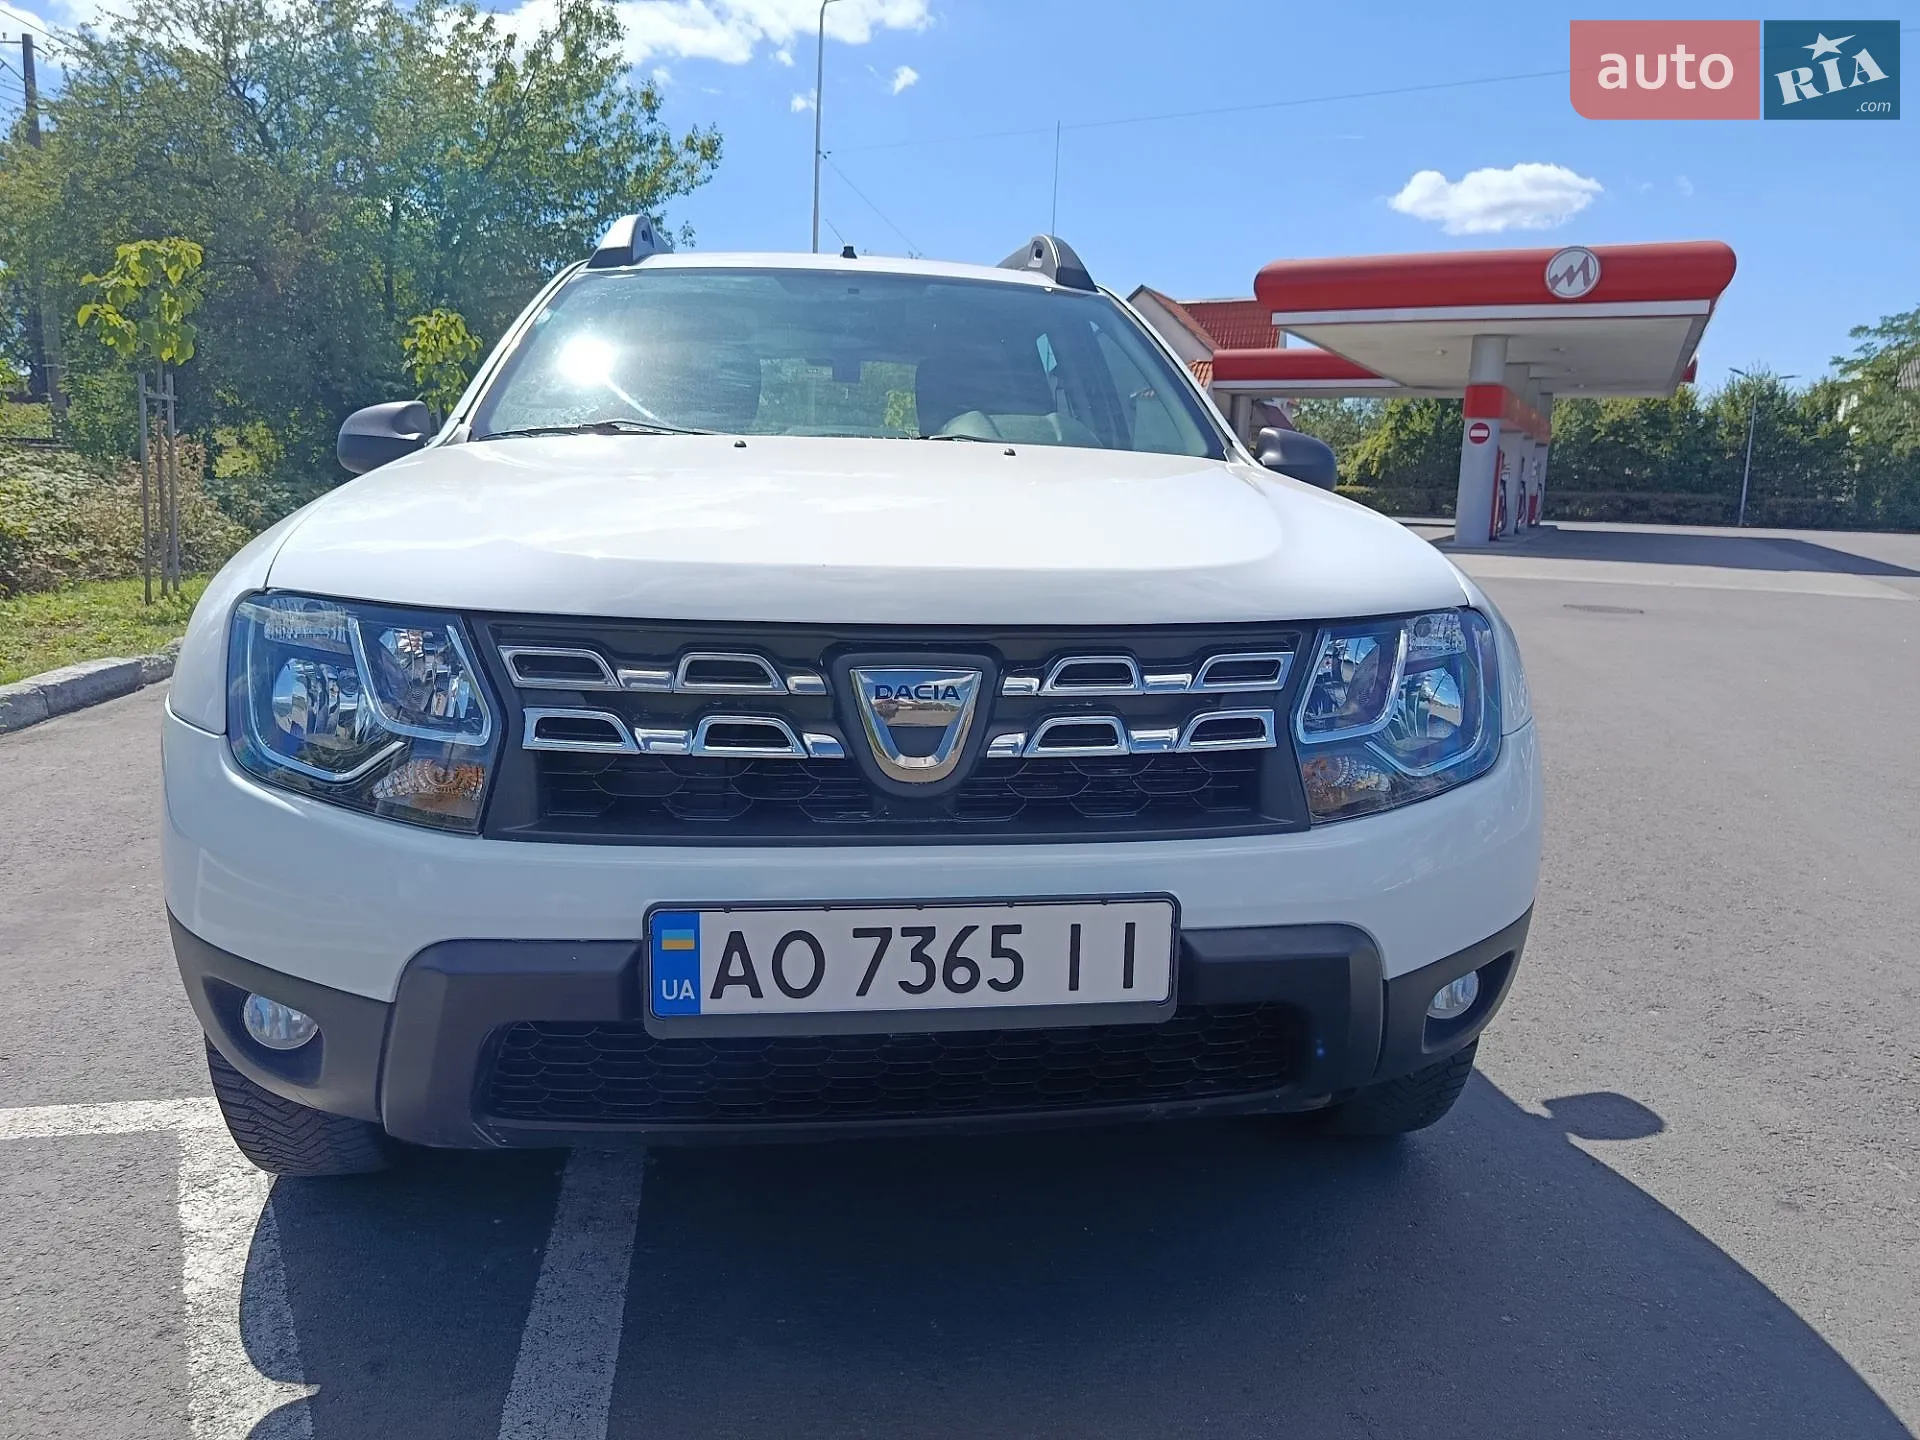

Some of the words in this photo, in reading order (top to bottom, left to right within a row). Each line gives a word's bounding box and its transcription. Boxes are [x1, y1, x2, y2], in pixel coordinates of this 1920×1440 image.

[875, 685, 961, 700] DACIA
[709, 930, 826, 999] AO
[852, 924, 1024, 996] 7365
[661, 979, 695, 1001] UA
